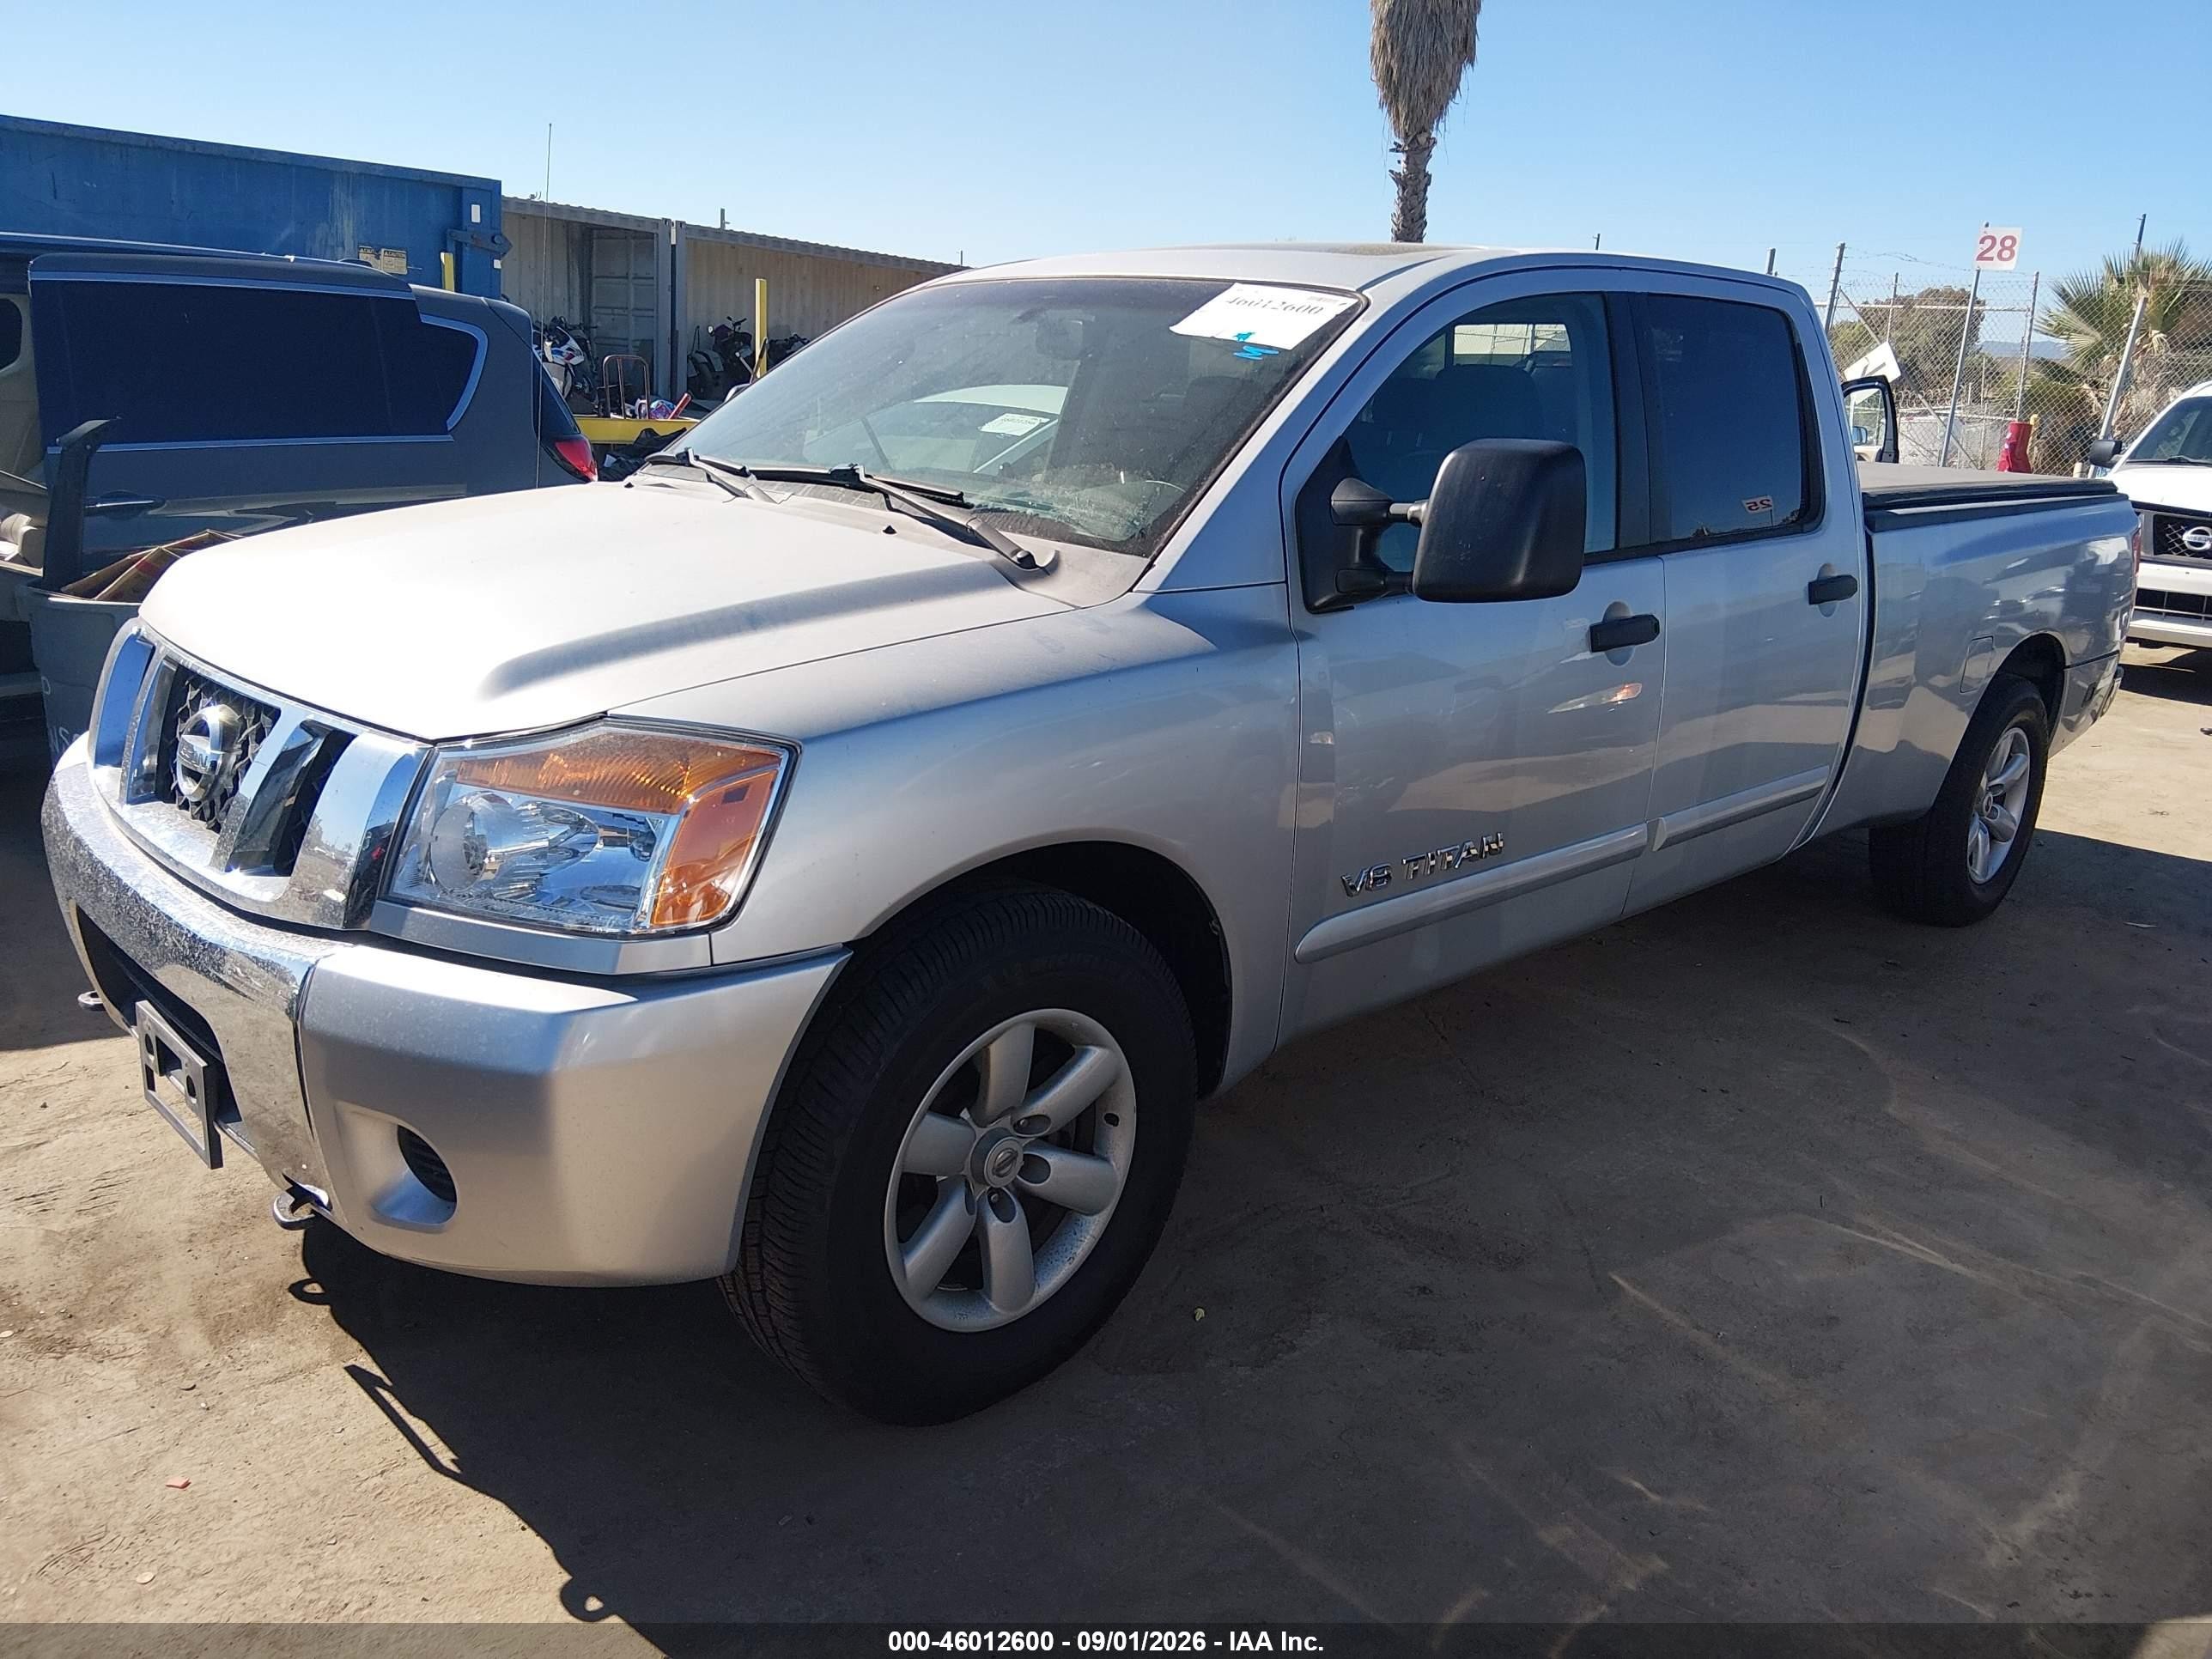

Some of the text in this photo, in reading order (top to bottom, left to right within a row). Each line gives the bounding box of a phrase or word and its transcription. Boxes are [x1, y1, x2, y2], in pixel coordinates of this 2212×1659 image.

[1976, 234, 2018, 262] 28
[1340, 831, 1504, 897] V8 TITAN
